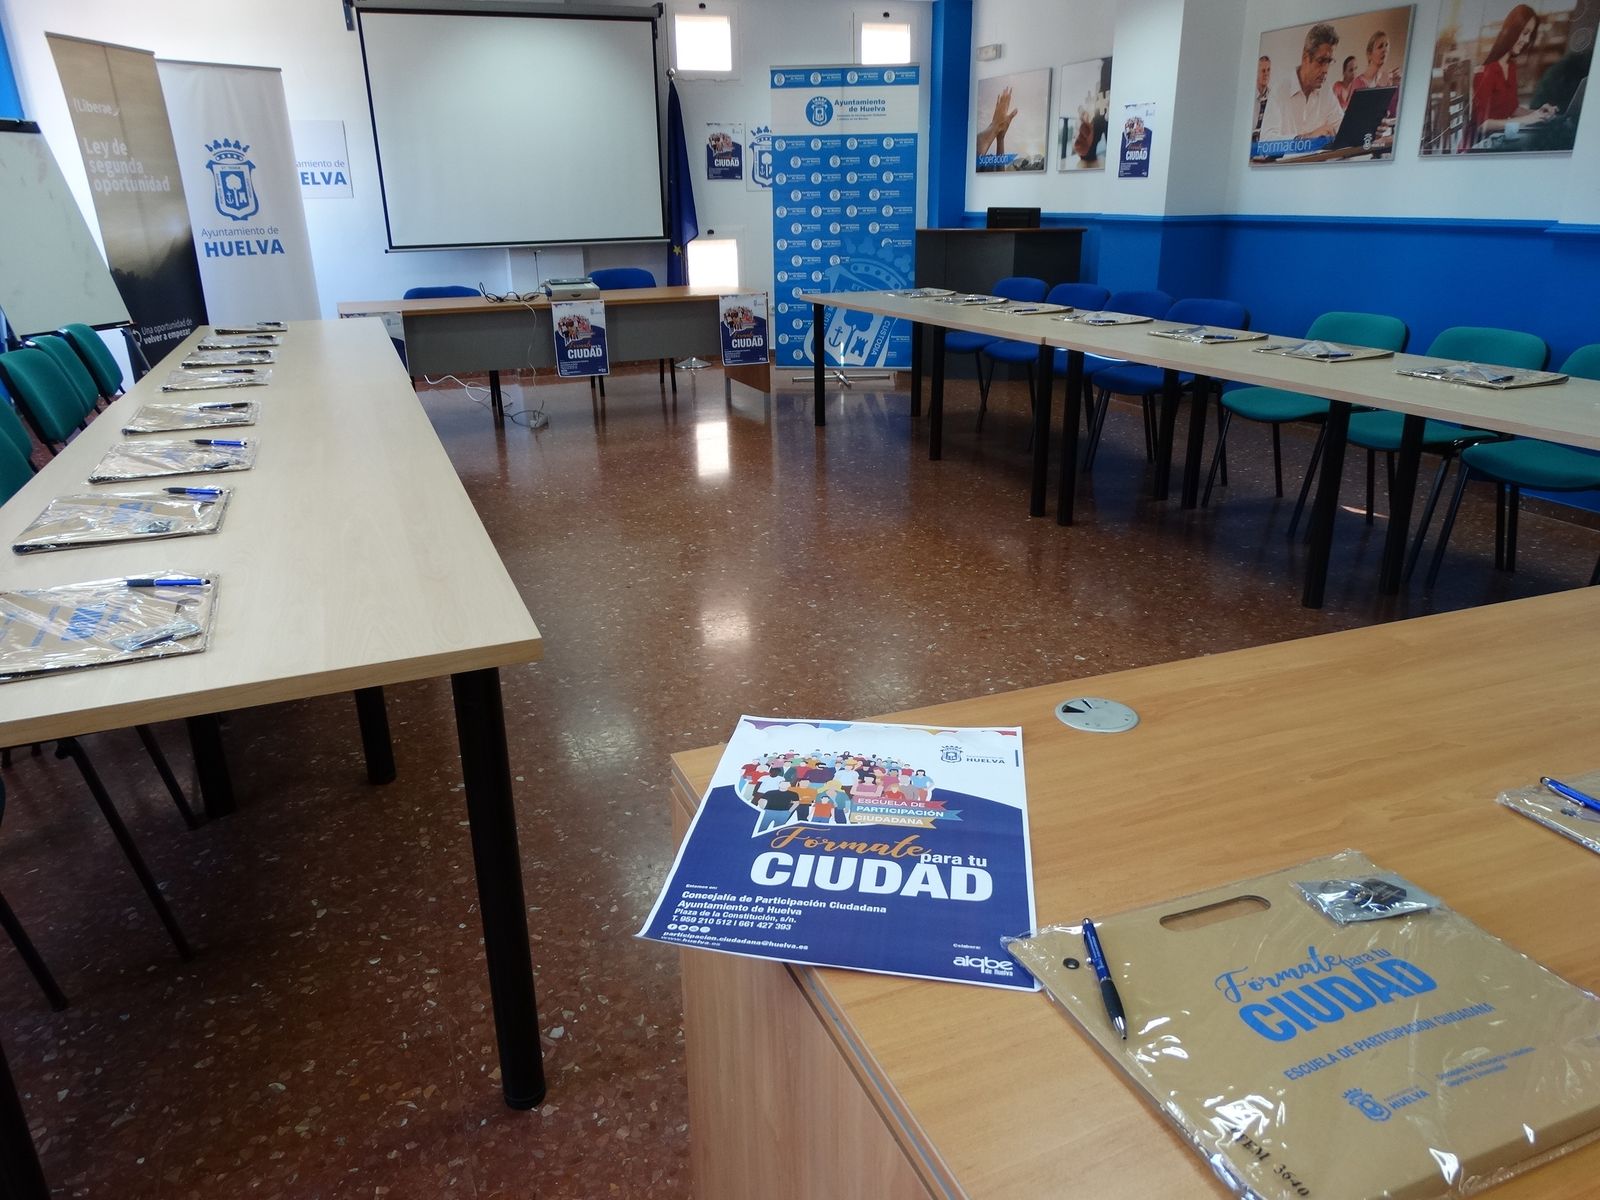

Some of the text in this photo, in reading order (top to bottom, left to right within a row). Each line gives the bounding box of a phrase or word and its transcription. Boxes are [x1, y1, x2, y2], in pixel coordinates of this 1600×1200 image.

[834, 99, 886, 107] Ayuntamiento
[83, 137, 128, 159] Ley de
[1125, 150, 1148, 161] CIUDAD
[88, 157, 144, 178] segunda
[296, 160, 346, 168] amiento de
[714, 158, 740, 167] CIUDAD
[94, 175, 171, 196] oportunidad
[300, 171, 348, 186] ELVA
[201, 225, 280, 239] Ayuntamiento de
[204, 238, 286, 258] HUELVA
[731, 337, 764, 349] CIUDAD
[567, 347, 603, 359] CIUDAD
[857, 798, 908, 807] ESCUELA
[854, 814, 923, 825] CIUDADANA
[856, 806, 944, 818] PARTICIPACIÓN
[919, 852, 963, 865] para
[968, 854, 988, 867] tu
[750, 851, 993, 902] CIUDAD
[677, 900, 802, 916] Ayuntamiento de Huelva
[681, 891, 887, 913] Concejalía de Participación Ciudadana
[674, 908, 698, 916] Plaza
[715, 918, 732, 926] 512
[738, 920, 754, 928] 661
[953, 955, 1014, 974] aiqbe
[1341, 952, 1374, 970] para
[1372, 948, 1392, 960] tu
[1238, 958, 1438, 1043] CIUDAD
[1283, 1001, 1497, 1081] ESCUELA DE PARTICIPACIÓN CIUDADANA
[1388, 1090, 1430, 1110] HUELVA
